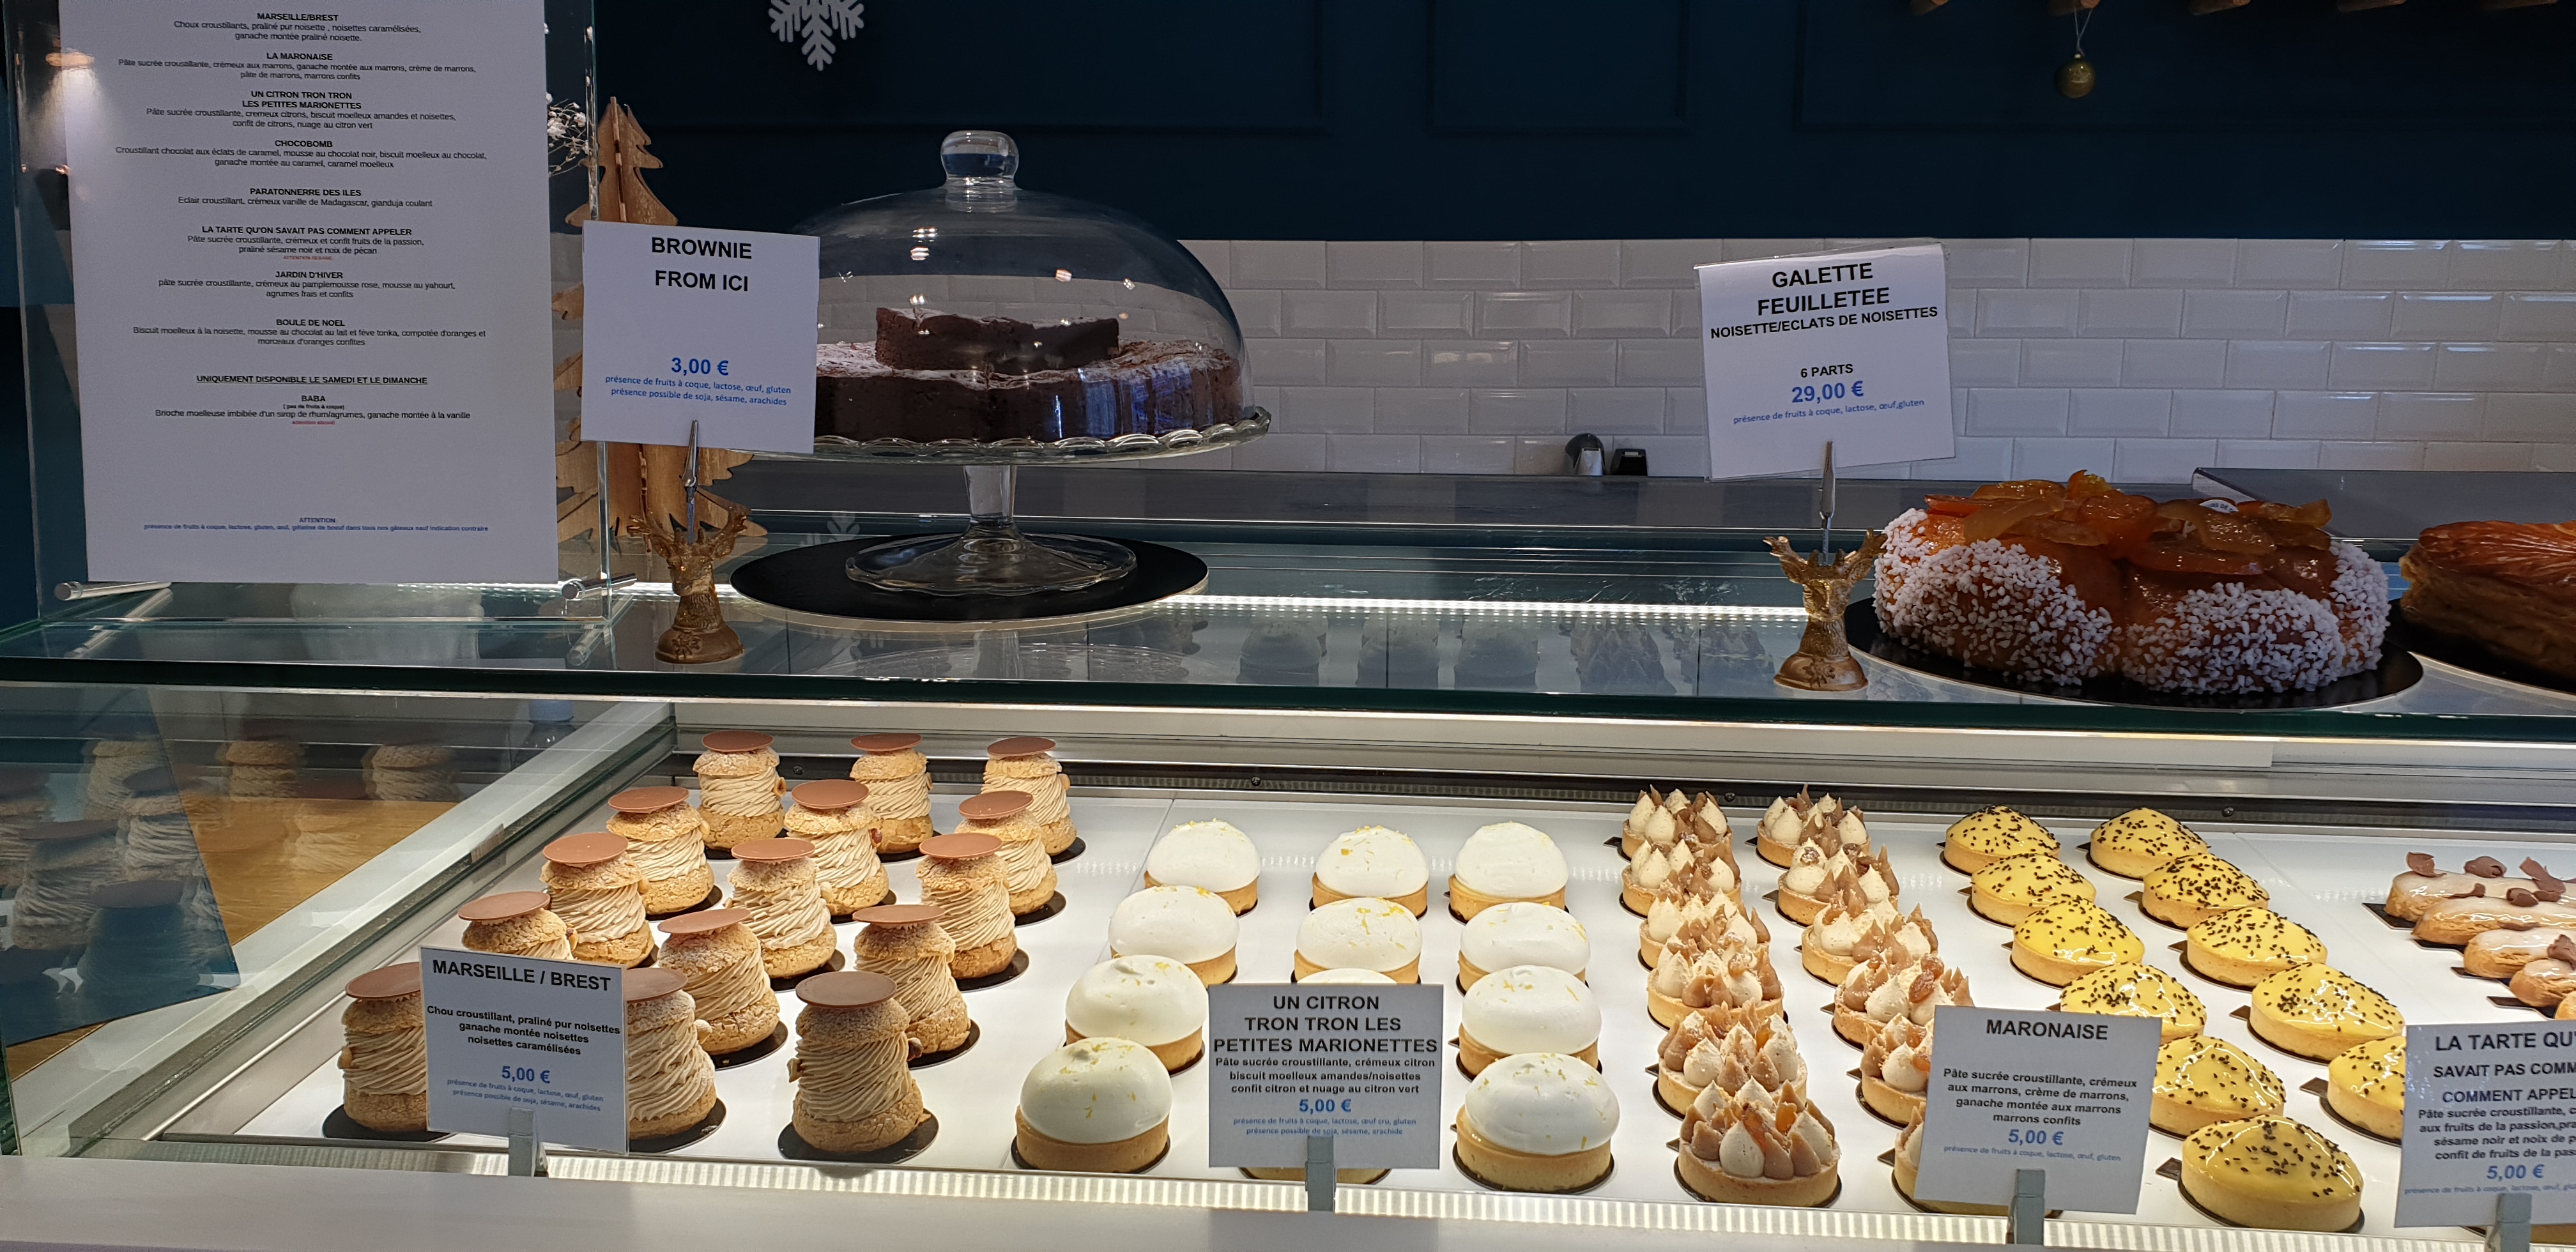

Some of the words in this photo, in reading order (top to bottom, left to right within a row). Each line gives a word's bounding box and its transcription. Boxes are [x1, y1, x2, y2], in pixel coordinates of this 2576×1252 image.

[257, 13, 339, 21] MARSEILLE/BREST
[280, 52, 333, 61] MARONAISE
[250, 188, 321, 196] PARATONNERRE
[652, 237, 752, 259] BROWNIE
[656, 270, 716, 289] FROM
[723, 275, 747, 291] ICI
[1772, 263, 1873, 287] GALETTE
[1758, 287, 1890, 316] FEUILLETEE
[1711, 316, 1835, 339] NOISETTE/ECLATS
[1839, 314, 1858, 326] DE
[1861, 307, 1938, 323] NOISETTES
[671, 357, 711, 376] 3,00
[717, 360, 729, 376] €
[1800, 368, 1807, 378] 6
[1811, 363, 1853, 377] PARTS
[196, 375, 254, 383] UNIQUEMENT
[605, 376, 641, 385] présence
[656, 378, 676, 386] fruits
[684, 381, 711, 390] coque,
[714, 382, 743, 392] lactose,
[746, 385, 764, 393] œuf,
[766, 386, 791, 394] gluten
[611, 388, 647, 397] présence
[695, 393, 713, 402] soja,
[716, 394, 747, 404] sésame,
[749, 397, 787, 406] arachides
[1791, 383, 1845, 404] 29,00
[1851, 380, 1864, 397] €
[1733, 415, 1770, 425] présence
[1879, 400, 1924, 409] œuf,gluten
[433, 959, 535, 982] MARSEILLE
[540, 971, 546, 984] /
[551, 972, 611, 991] BREST
[1273, 996, 1300, 1009] UN
[1307, 996, 1379, 1010] CITRON
[427, 1005, 453, 1016] Chou
[456, 1011, 515, 1024] croustillant,
[518, 1017, 552, 1027] praliné
[555, 1021, 572, 1029] pur
[574, 1023, 620, 1034] noisettes
[1245, 1017, 1298, 1031] TRON
[1305, 1017, 1358, 1031] TRON
[1365, 1018, 1401, 1031] LES
[459, 1023, 501, 1033] ganache
[503, 1028, 540, 1037] montée
[543, 1032, 589, 1043] noisettes
[1986, 1019, 2108, 1040] MARONAISE
[468, 1036, 513, 1047] noisettes
[516, 1042, 581, 1055] caramélisées
[1213, 1038, 1292, 1052] PETITES
[1299, 1039, 1438, 1052] MARIONETTES
[2435, 1036, 2462, 1051] LA
[2468, 1033, 2536, 1050] TARTE
[1216, 1057, 1239, 1066] Pâte
[1243, 1057, 1278, 1066] sucrée
[1282, 1057, 1351, 1067] croustillante,
[1355, 1058, 1400, 1066] crémeux
[1404, 1058, 1435, 1067] citron
[502, 1065, 535, 1082] 5,00
[540, 1070, 550, 1084] €
[1230, 1071, 1266, 1080] biscuit
[1269, 1071, 1317, 1080] moelleux
[1321, 1071, 1420, 1080] amandes/noisettes
[1943, 1068, 1968, 1078] Pâte
[1972, 1071, 2009, 1081] sucrée
[2012, 1074, 2085, 1087] croustillante,
[2089, 1078, 2137, 1087] crémeux
[2433, 1064, 2490, 1078] SAVAIT
[2494, 1064, 2526, 1076] PAS
[1231, 1084, 1262, 1093] confit
[1265, 1084, 1296, 1093] citron
[1300, 1085, 1309, 1093] et
[1313, 1086, 1345, 1094] nuage
[1365, 1084, 1395, 1093] citron
[1399, 1085, 1419, 1094] vert
[1971, 1086, 2021, 1097] marrons,
[2025, 1087, 2060, 1097] crème
[2063, 1089, 2076, 1098] de
[2080, 1092, 2129, 1102] marrons,
[2442, 1089, 2523, 1103] COMMENT
[1300, 1099, 1335, 1115] 5,00
[1340, 1099, 1351, 1112] €
[1956, 1099, 2004, 1108] ganache
[2007, 1101, 2048, 1110] montée
[2074, 1106, 2121, 1114] marrons
[2418, 1109, 2444, 1118] Pâte
[2447, 1108, 2487, 1118] sucrée
[2490, 1106, 2566, 1117] croustillante,
[1993, 1115, 2039, 1123] marrons
[2043, 1116, 2081, 1126] confits
[2008, 1129, 2046, 1146] 5,00
[2052, 1131, 2064, 1145] €
[2487, 1164, 2527, 1181] 5,00
[2532, 1164, 2545, 1179] €
